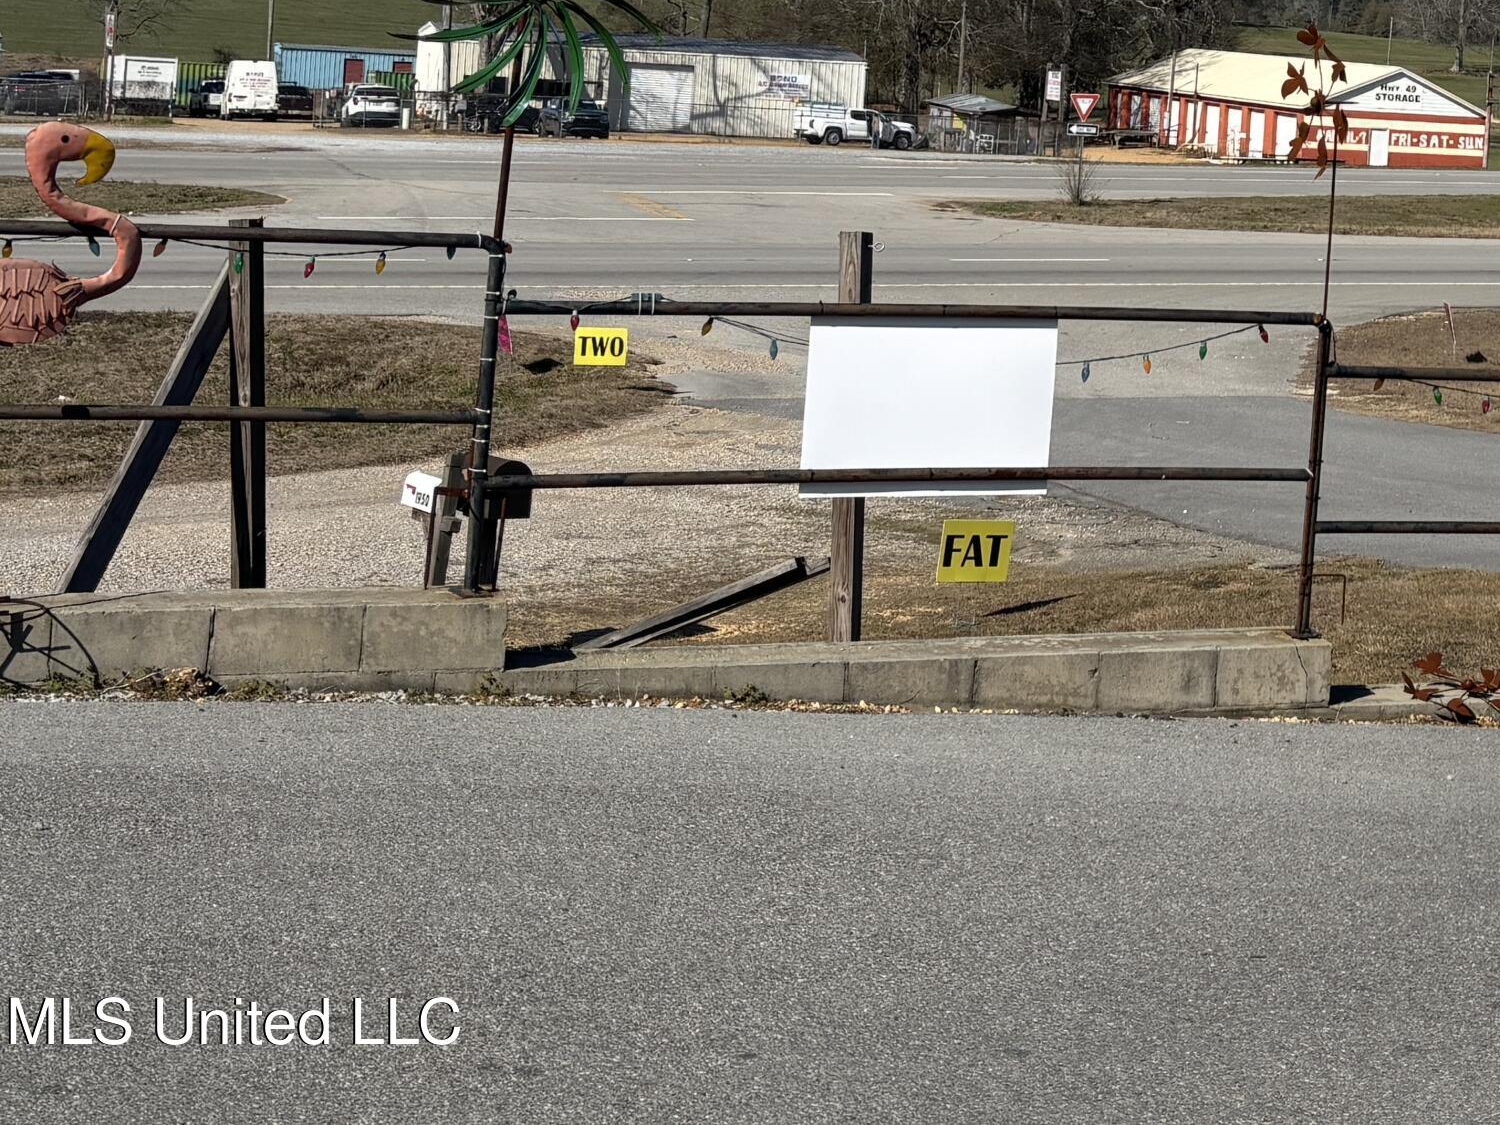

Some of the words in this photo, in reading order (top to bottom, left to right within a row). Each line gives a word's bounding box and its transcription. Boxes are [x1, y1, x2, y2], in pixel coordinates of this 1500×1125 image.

[1406, 85, 1417, 93] 49
[1375, 93, 1421, 103] STORAGE
[578, 336, 624, 357] TWO
[943, 535, 1008, 567] FAT
